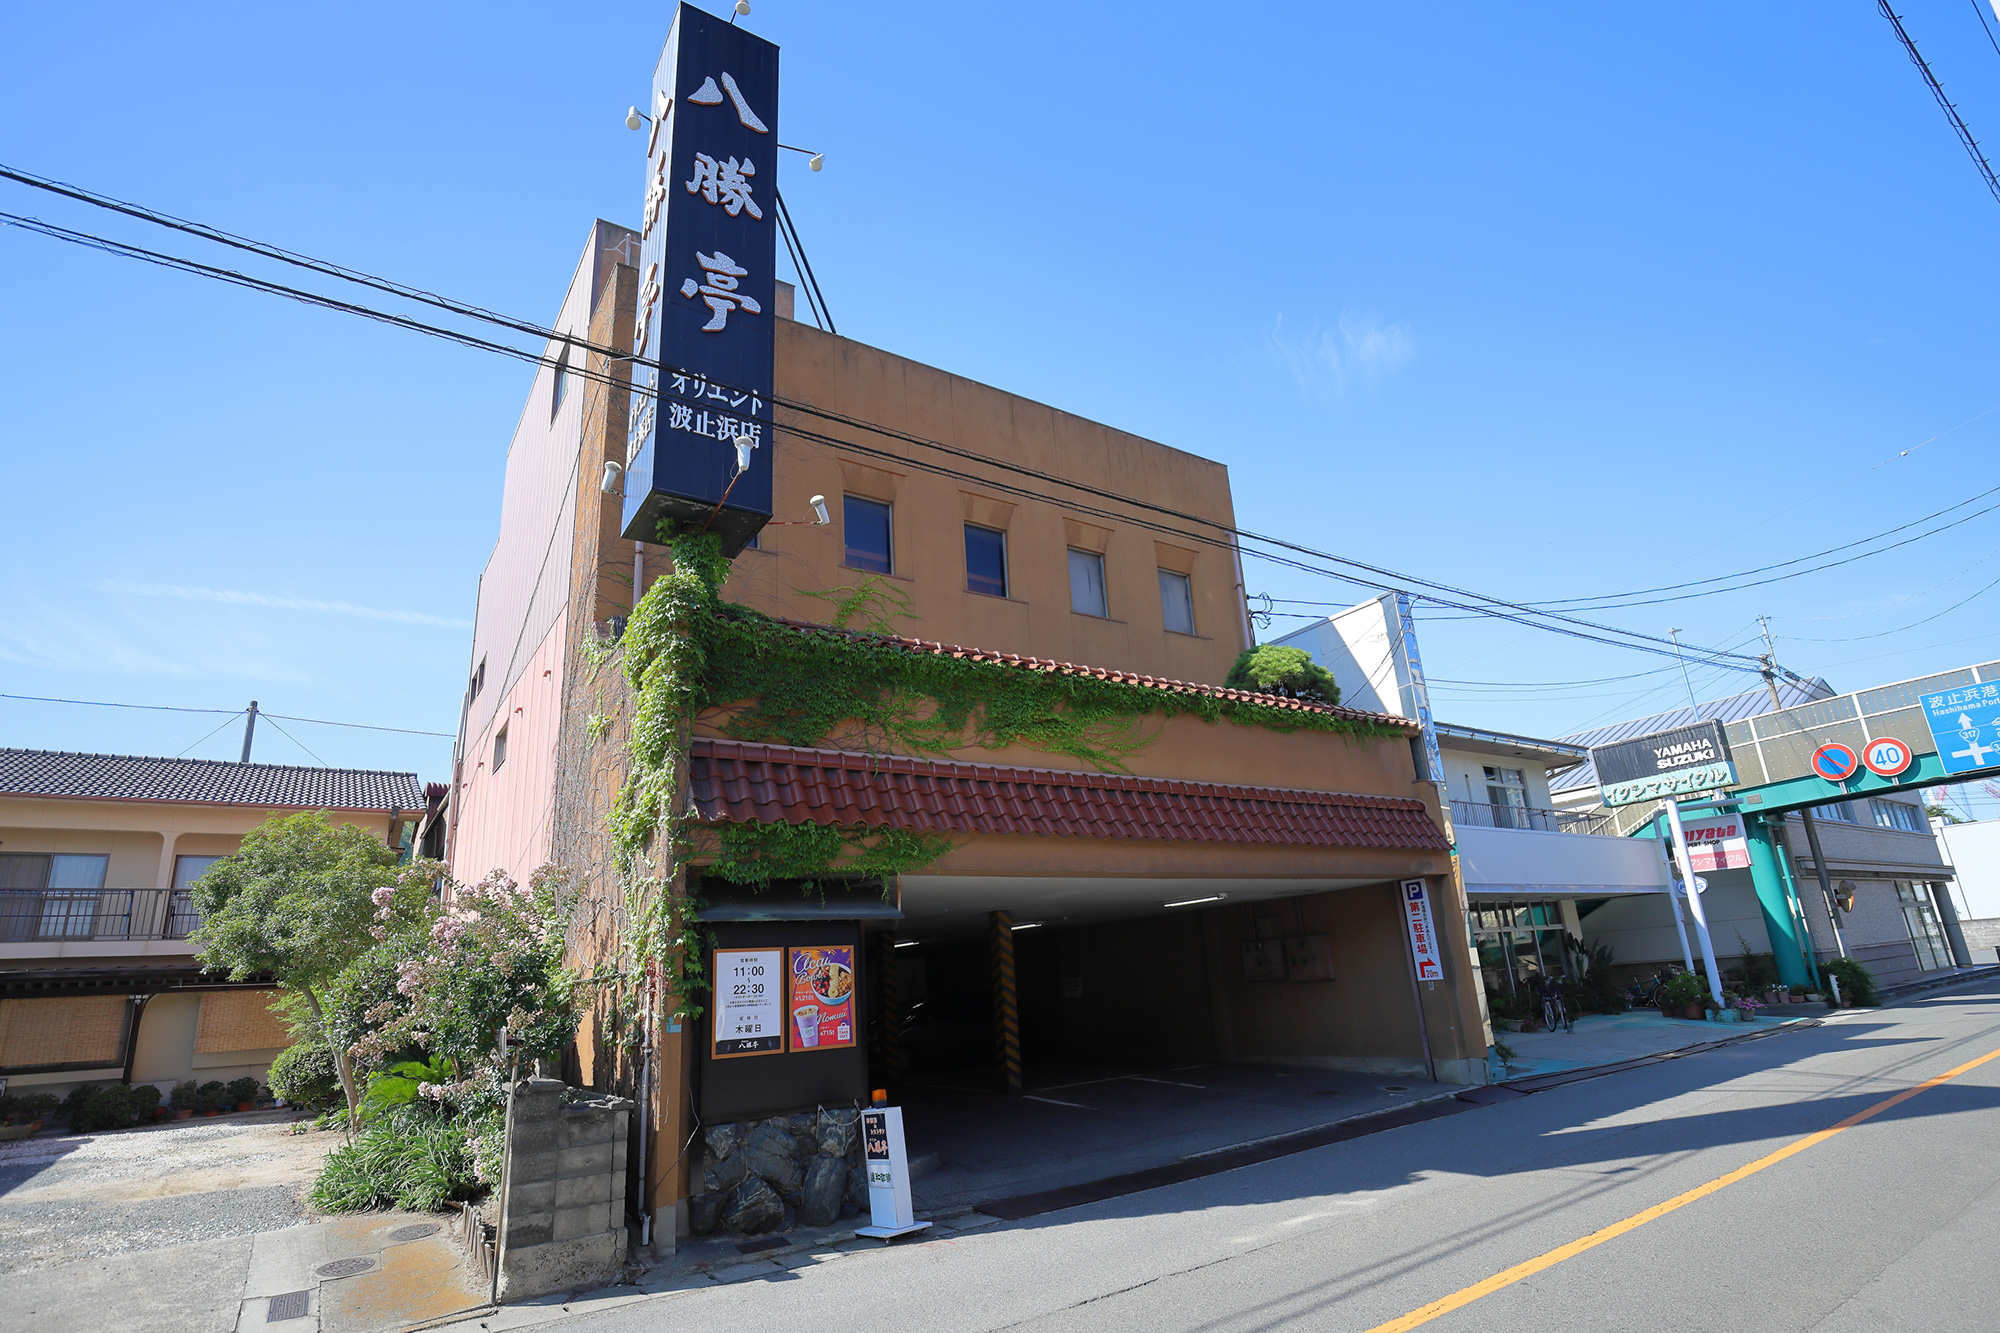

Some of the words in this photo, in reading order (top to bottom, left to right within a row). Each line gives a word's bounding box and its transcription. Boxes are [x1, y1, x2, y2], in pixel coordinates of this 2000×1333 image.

[680, 71, 769, 333] 八勝亭
[669, 367, 764, 416] オリエント
[668, 401, 762, 450] 波止浜店
[1928, 684, 1999, 709] 波止浜港
[1932, 702, 1981, 716] Hashihama
[1962, 730, 1976, 739] 317
[1653, 738, 1713, 759] YAMAHA
[1875, 747, 1900, 765] 40
[1656, 748, 1715, 769] SUZUKI
[1605, 767, 1727, 802] イクシマサイクル
[1690, 853, 1744, 867] クシマサイクル
[1408, 884, 1420, 898] P
[1409, 901, 1428, 955] 第二駐車場
[733, 965, 765, 976] 11:00
[1426, 969, 1439, 978] 20m
[733, 983, 765, 995] 22:30
[735, 1024, 762, 1034] 木曜日
